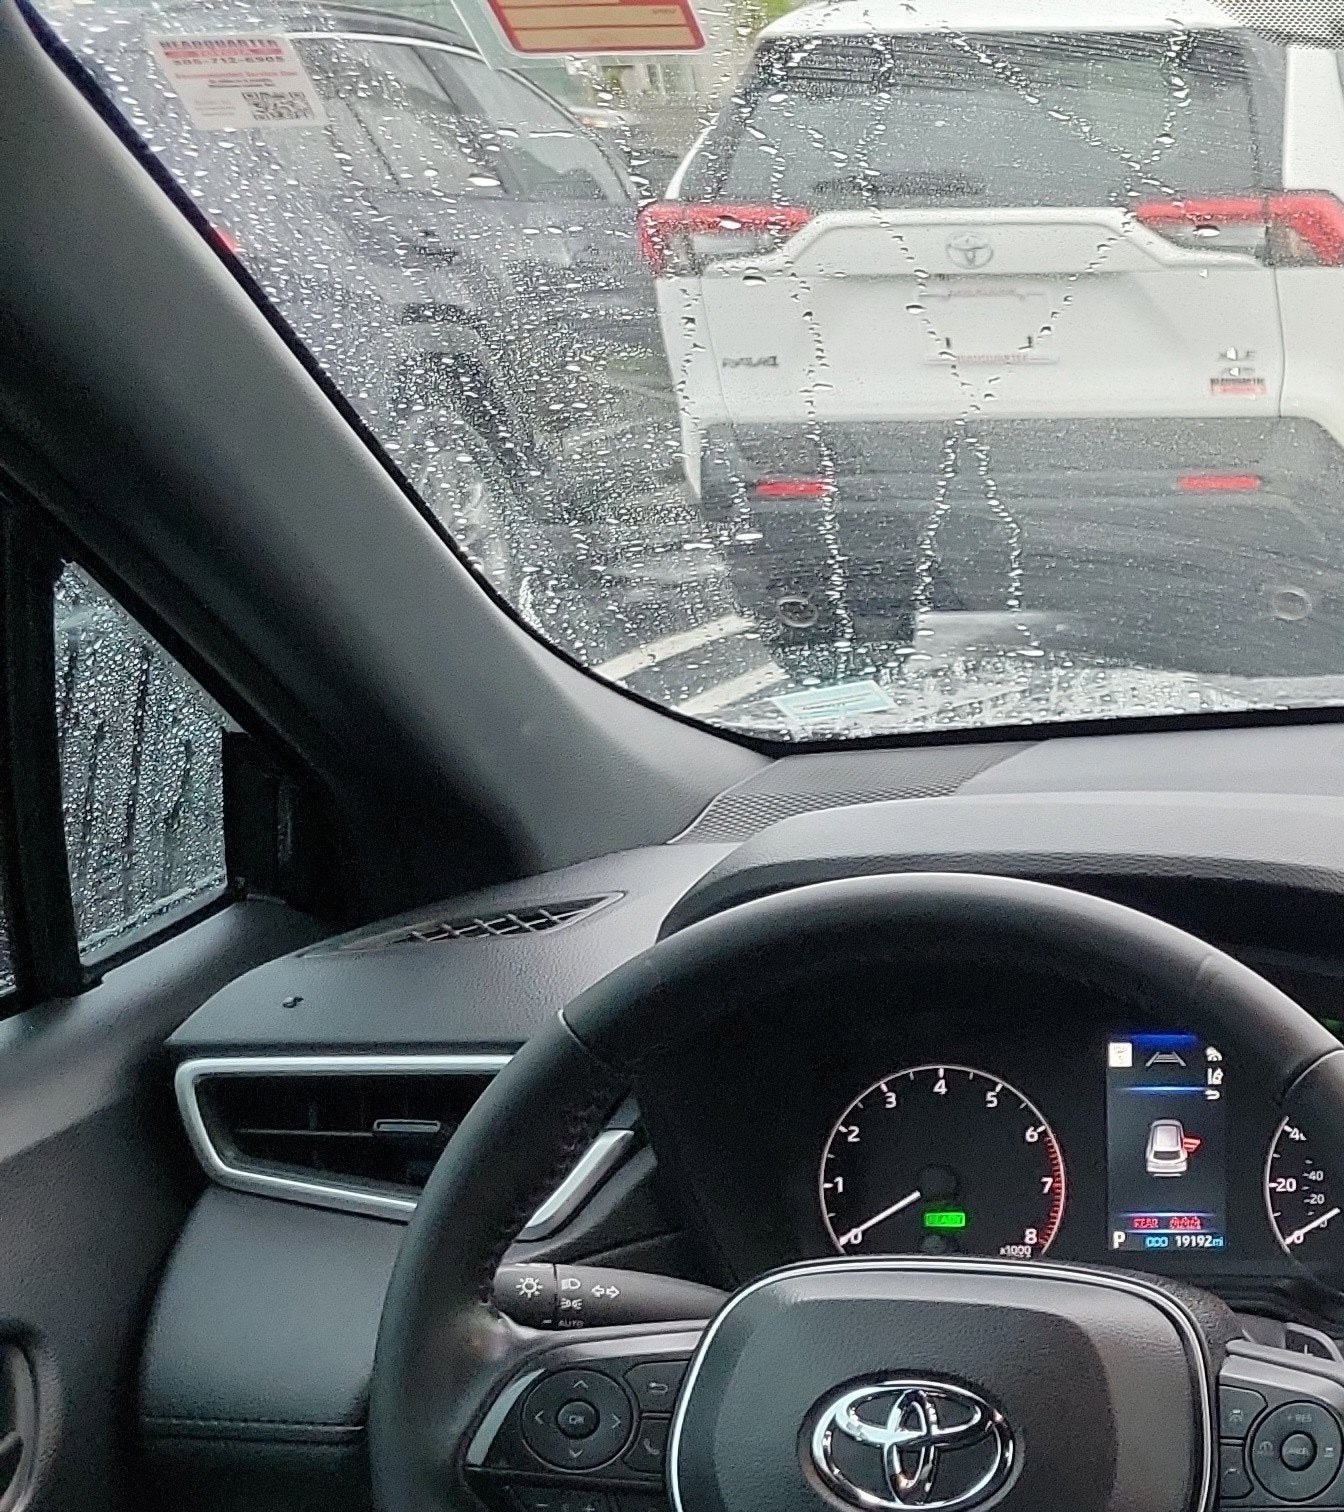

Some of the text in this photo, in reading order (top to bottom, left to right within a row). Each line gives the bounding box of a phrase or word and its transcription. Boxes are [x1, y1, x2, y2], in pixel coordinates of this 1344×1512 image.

[933, 1079, 948, 1095] 4
[884, 1092, 897, 1109] 3
[985, 1091, 998, 1108] 5
[847, 1126, 861, 1143] 2
[1025, 1126, 1039, 1143] 6
[833, 1176, 844, 1193] 1
[1308, 1170, 1324, 1182] 40
[1040, 1177, 1053, 1194] 7
[1275, 1178, 1297, 1192] 20
[1309, 1193, 1325, 1205] 20
[1024, 1228, 1037, 1245] 8
[1112, 1231, 1126, 1249] P
[1000, 1245, 1032, 1257] x1000
